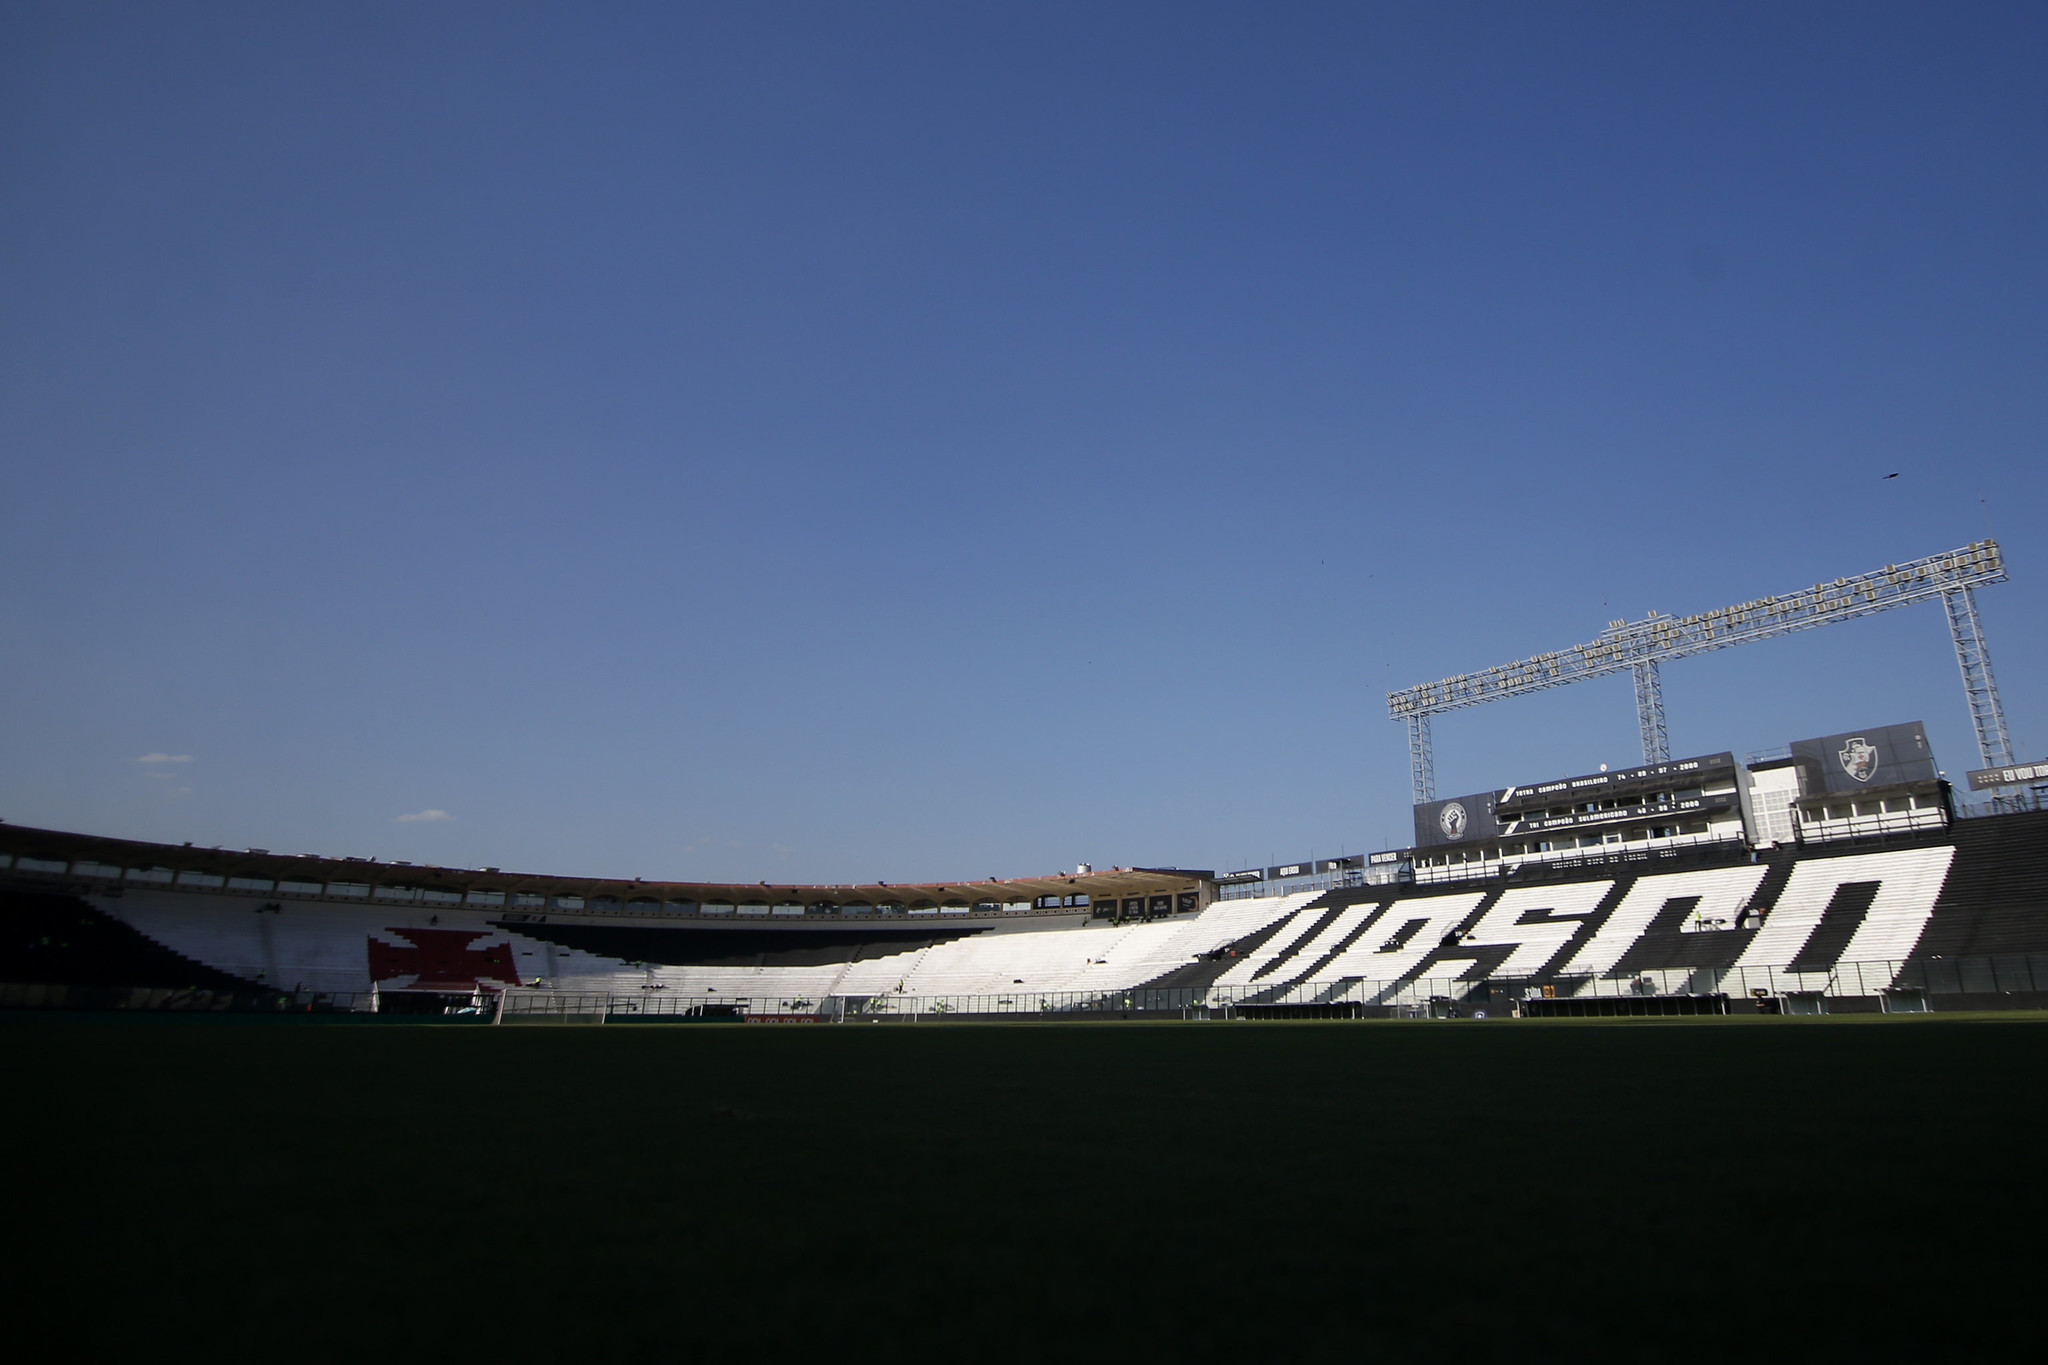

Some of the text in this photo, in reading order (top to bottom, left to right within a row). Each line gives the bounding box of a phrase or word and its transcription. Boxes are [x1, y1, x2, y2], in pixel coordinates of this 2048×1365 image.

[1516, 789, 1534, 797] TETRA
[1538, 782, 1568, 793] CAMPEÃO
[1572, 776, 1609, 788] BRASILEIRO
[1679, 761, 1699, 771] 2000
[2003, 769, 2016, 782] EU
[2014, 766, 2034, 780] VOU
[1544, 816, 1574, 827] CAMPEÃO
[1680, 800, 1700, 809] 2000
[1205, 845, 1957, 1008] VASCO
